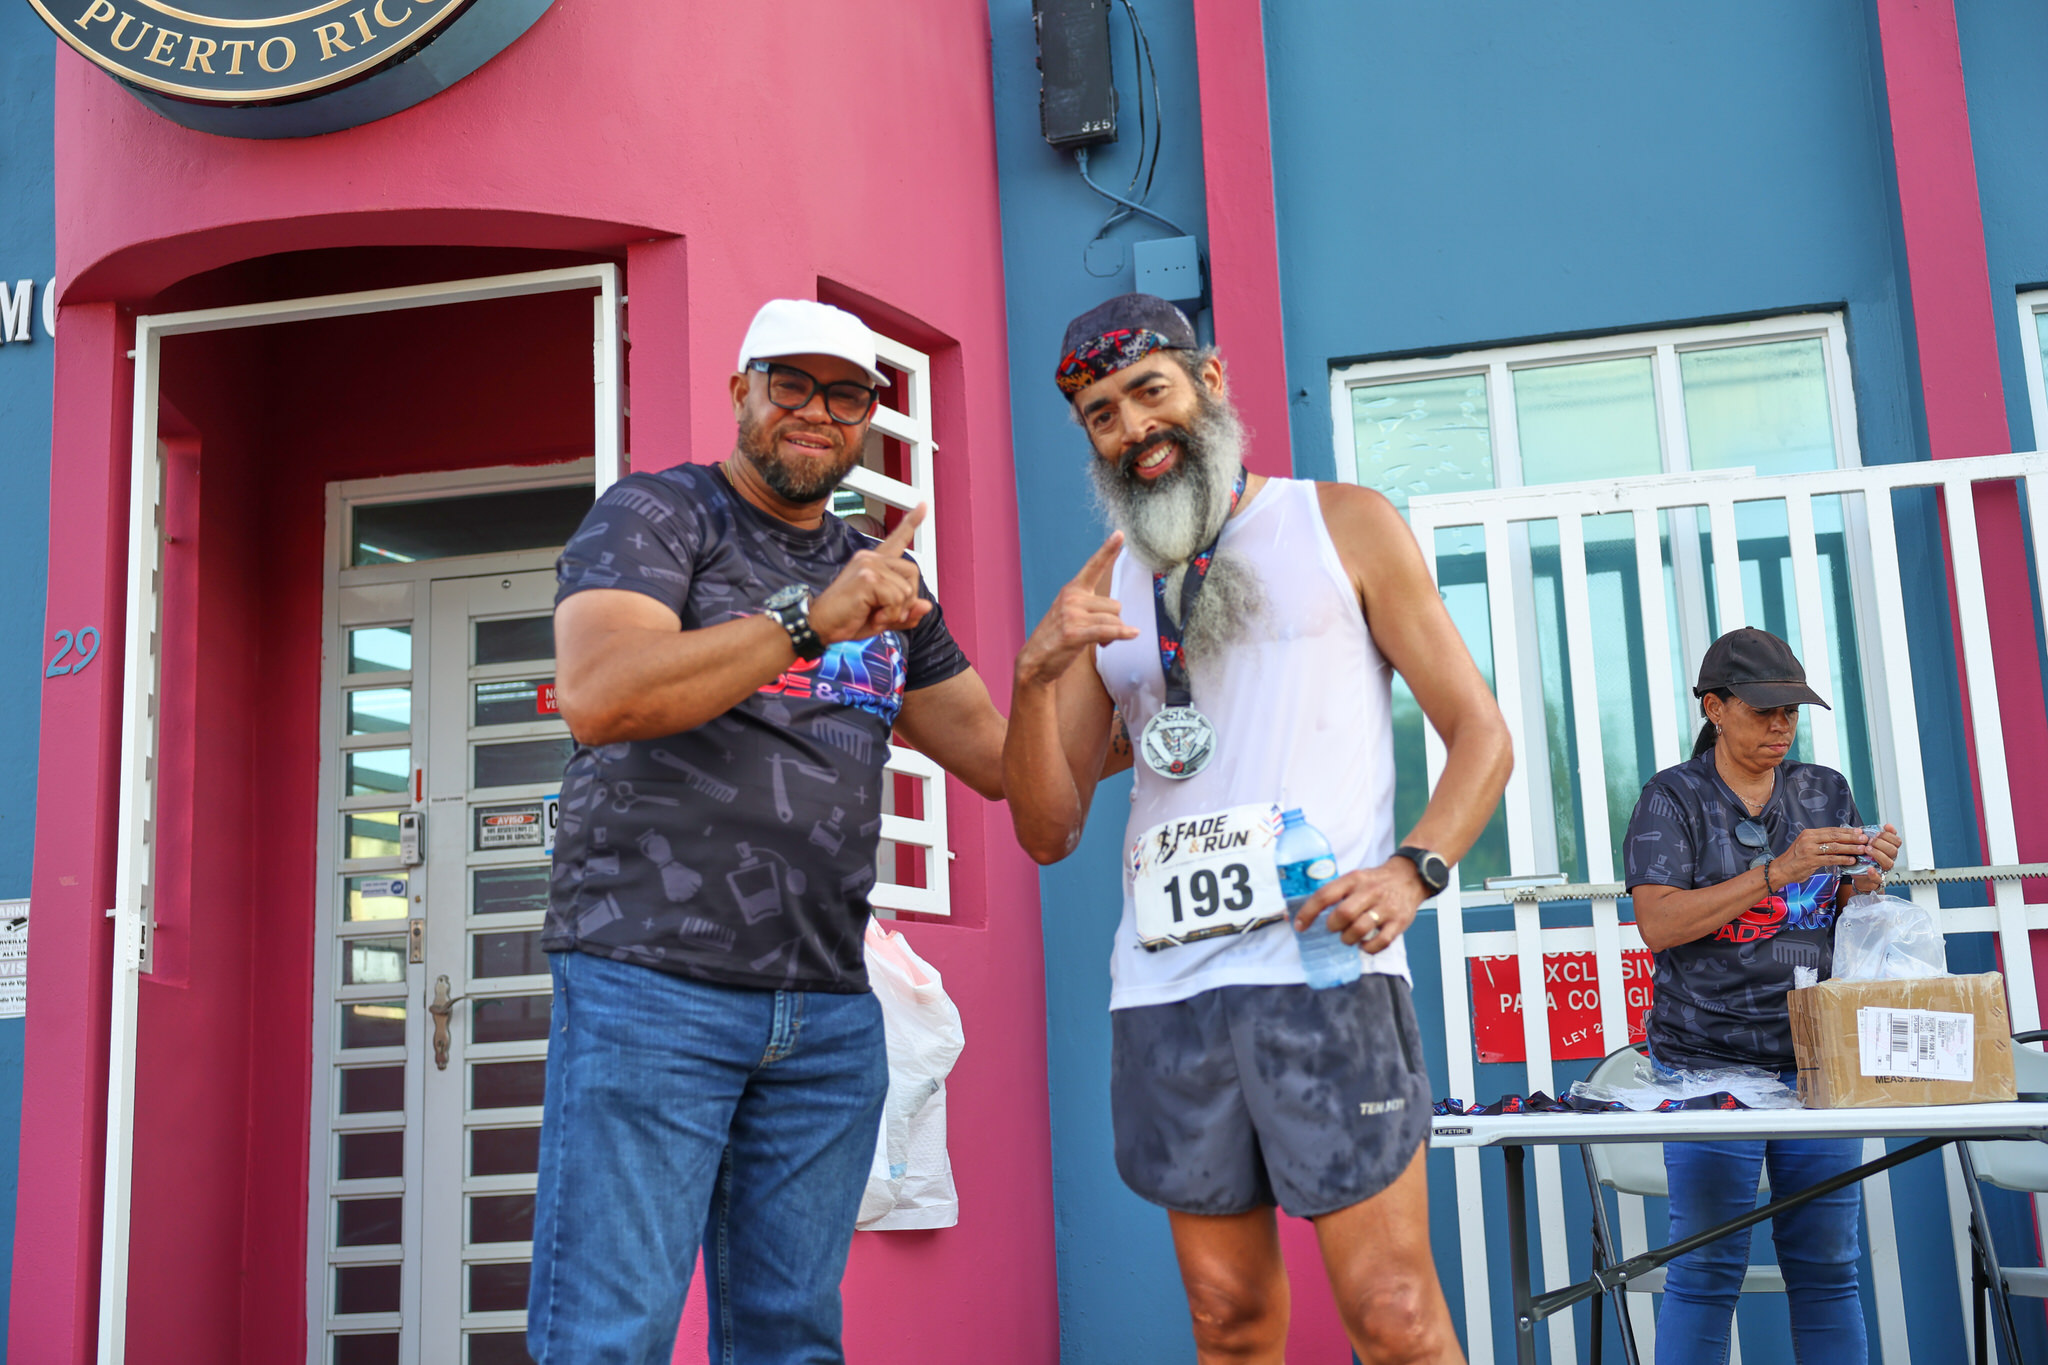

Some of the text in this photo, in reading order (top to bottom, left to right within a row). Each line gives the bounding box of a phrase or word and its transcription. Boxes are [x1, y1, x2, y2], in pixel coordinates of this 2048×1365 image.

[74, 0, 438, 75] PUERTO RIC
[1081, 119, 1111, 132] 325
[46, 626, 101, 678] 29
[1175, 814, 1228, 839] FADE
[1189, 831, 1250, 853] & RUN
[1163, 863, 1253, 923] 193
[1711, 924, 1782, 943] ADE
[1500, 991, 1558, 1013] PAA
[1562, 1028, 1588, 1047] LEY
